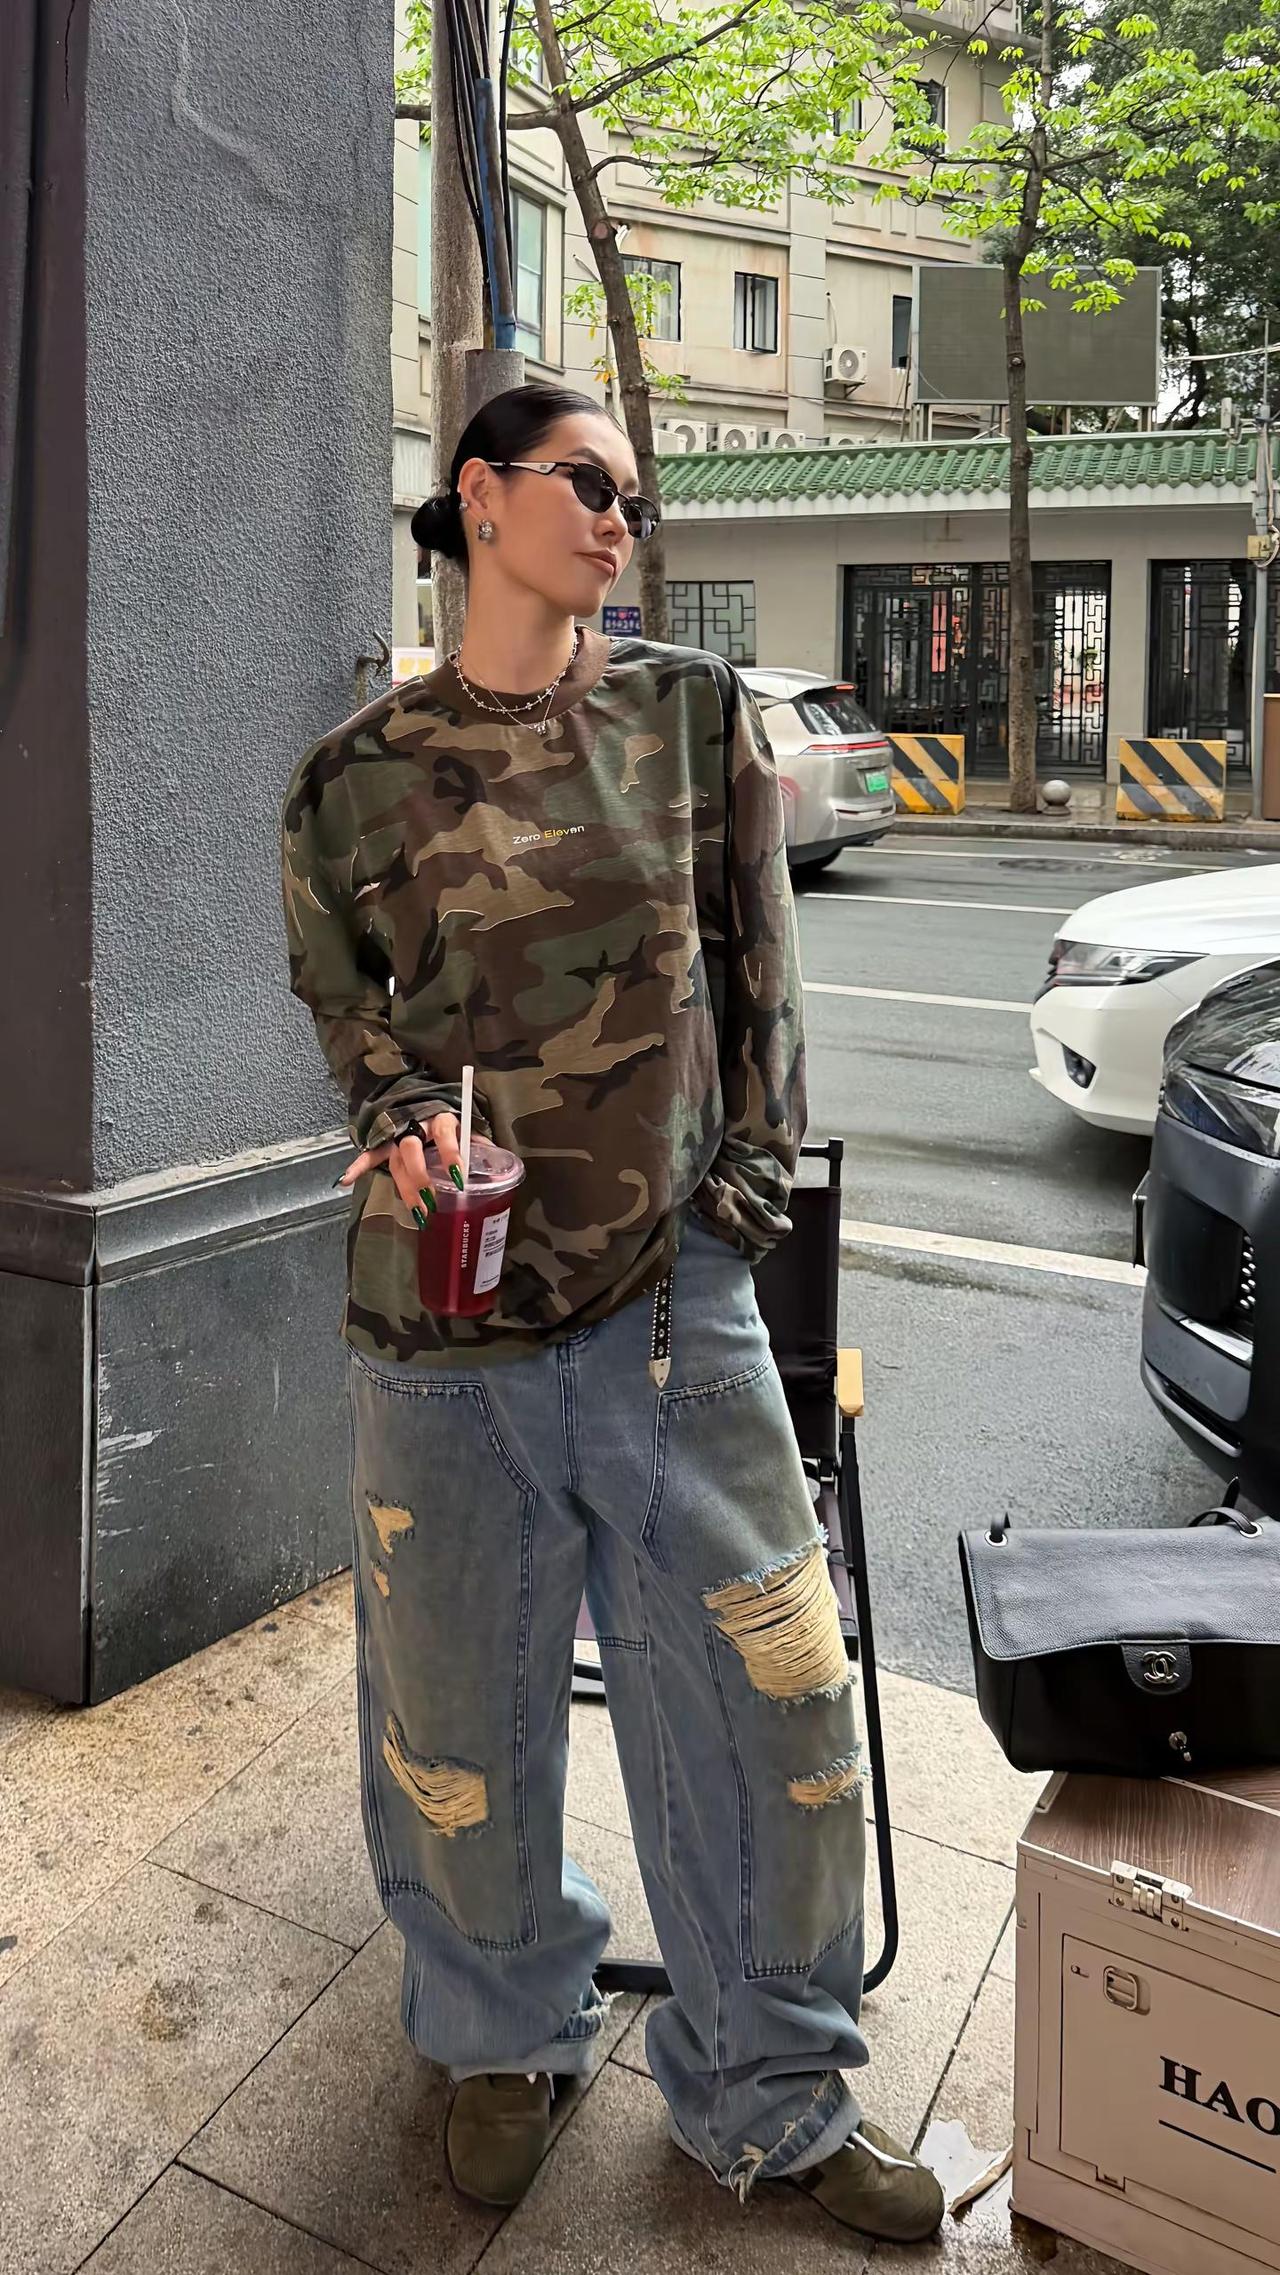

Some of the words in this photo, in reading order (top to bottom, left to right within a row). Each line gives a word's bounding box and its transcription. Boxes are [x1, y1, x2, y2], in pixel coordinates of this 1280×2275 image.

[512, 833, 541, 845] Zero
[544, 825, 585, 839] Eleven
[461, 1223, 470, 1269] STARBUCKS
[1158, 2055, 1280, 2136] HAO
